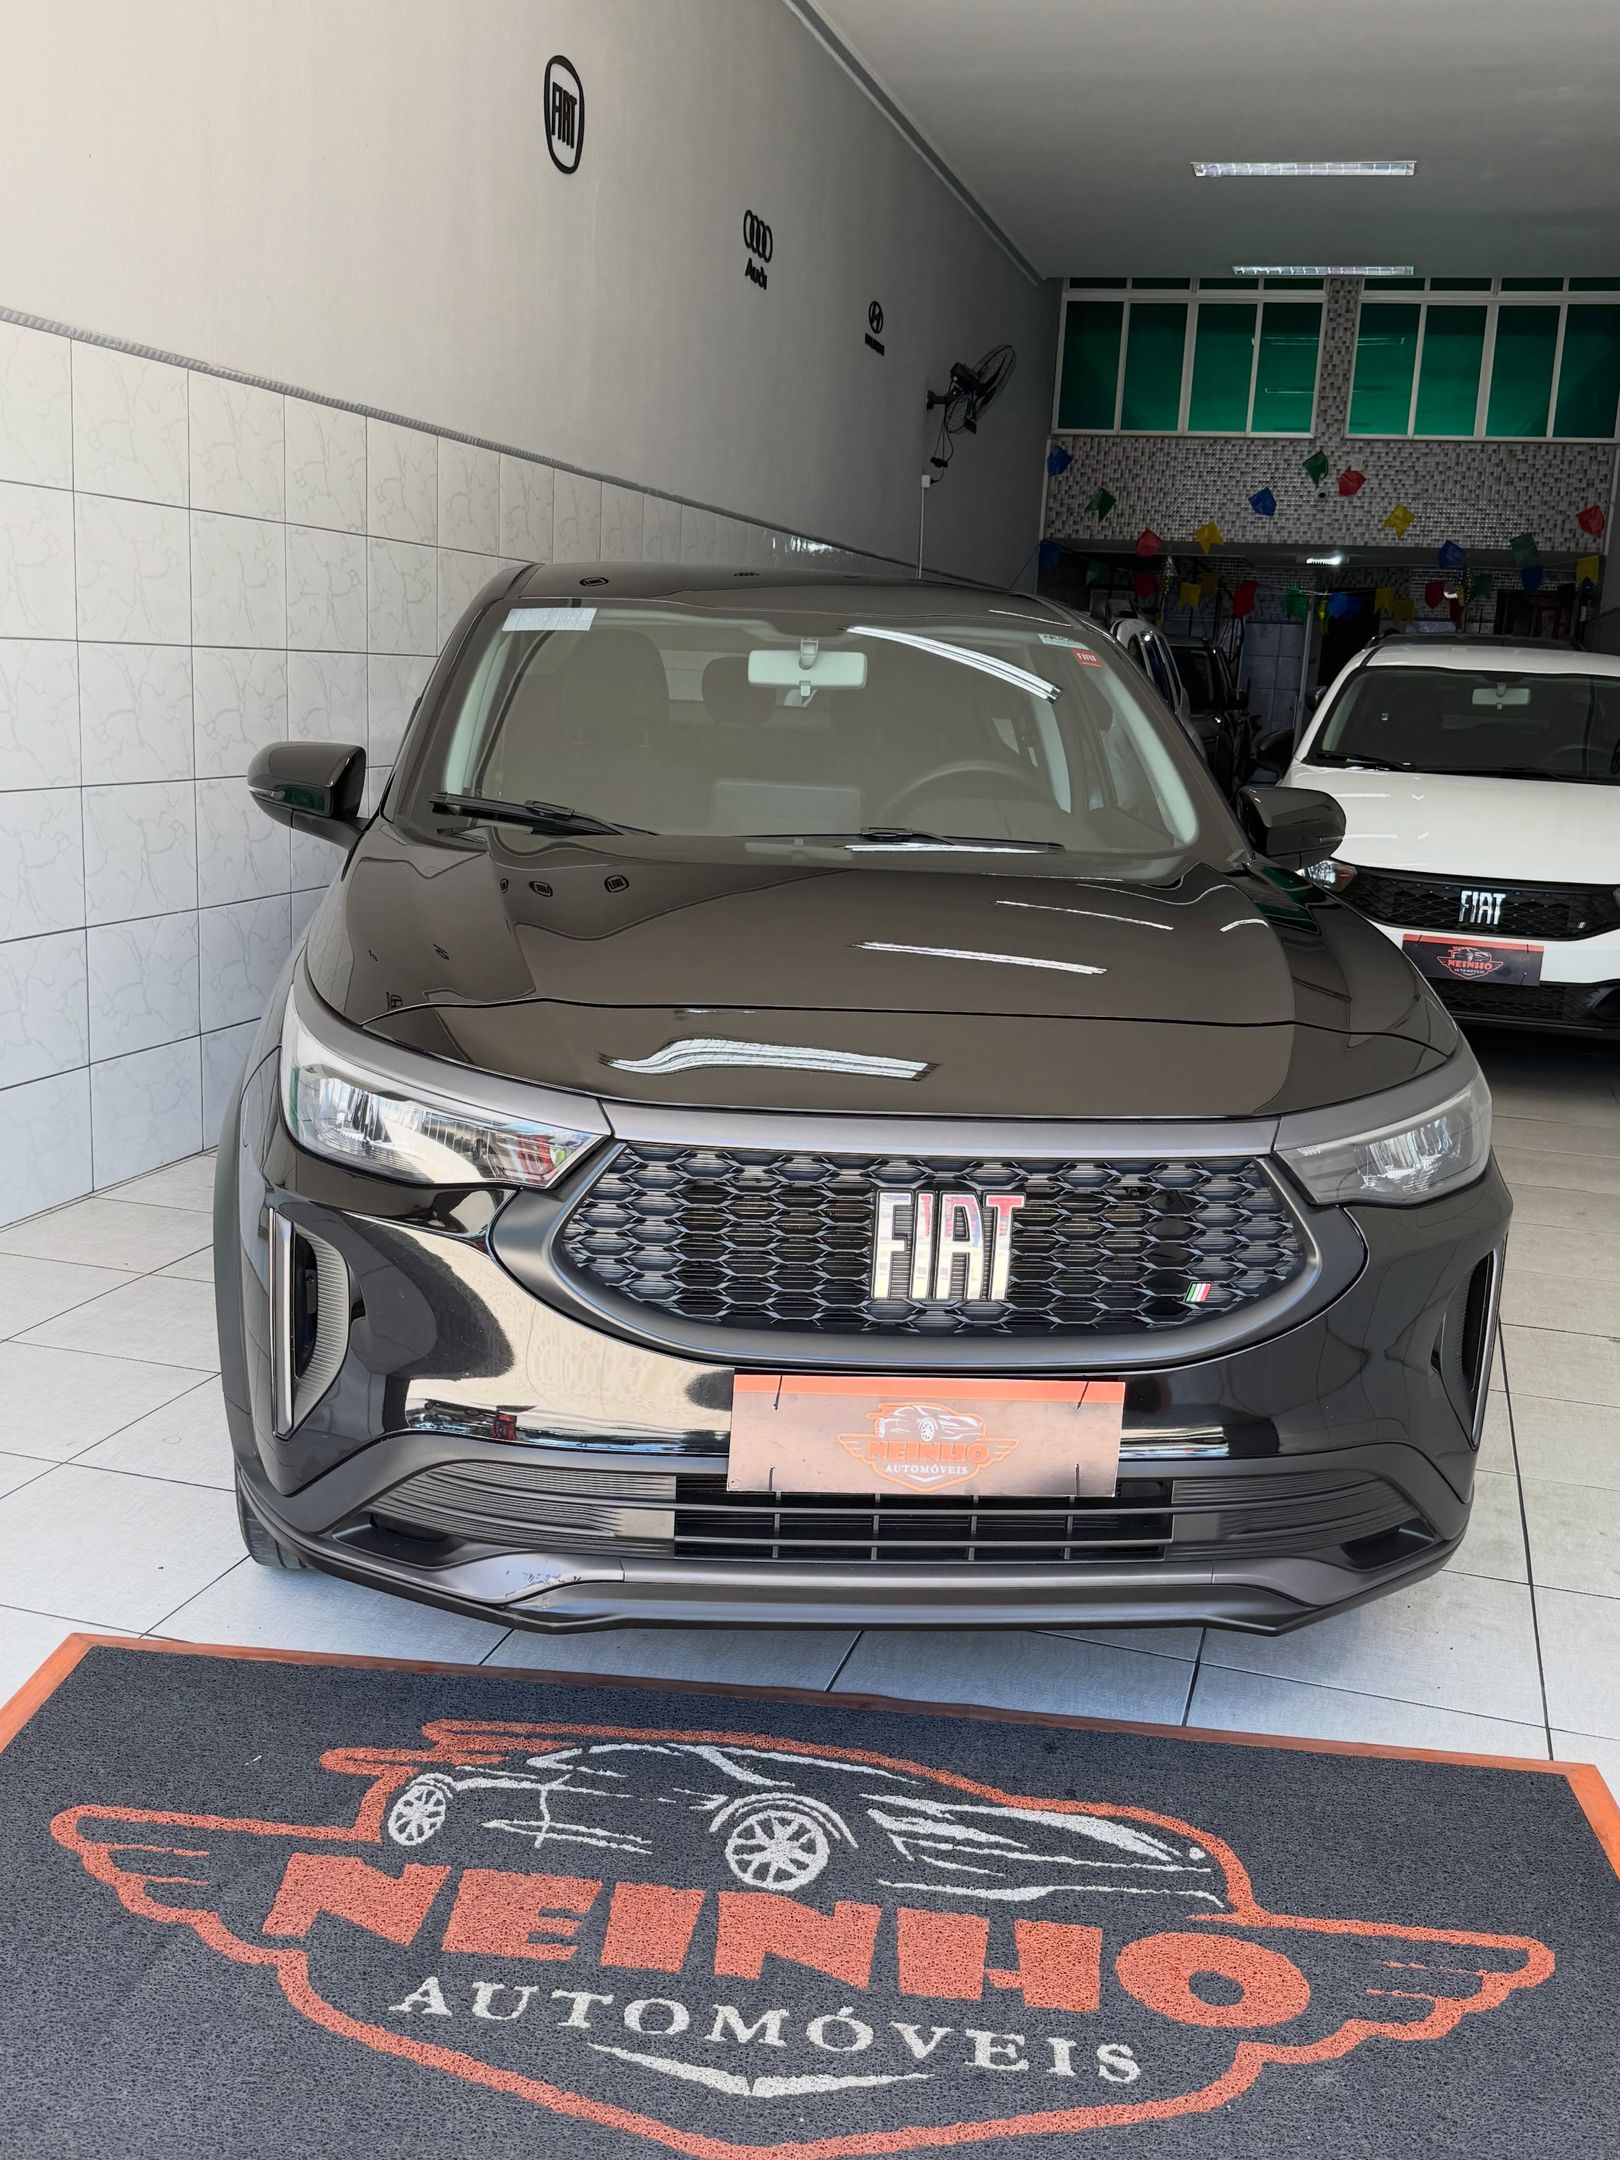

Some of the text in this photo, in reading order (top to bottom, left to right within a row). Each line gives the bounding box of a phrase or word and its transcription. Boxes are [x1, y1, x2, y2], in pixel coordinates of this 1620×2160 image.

[551, 82, 577, 149] FIAT
[745, 257, 768, 290] Audi
[1458, 890, 1506, 925] FIAT
[872, 1190, 1026, 1300] FIAT
[867, 1440, 990, 1464] NEINHO
[885, 1464, 969, 1475] AUTOMÓVEIS
[261, 1852, 1311, 2029] NEINHO
[388, 1975, 1141, 2083] AUTOMÓVEIS
